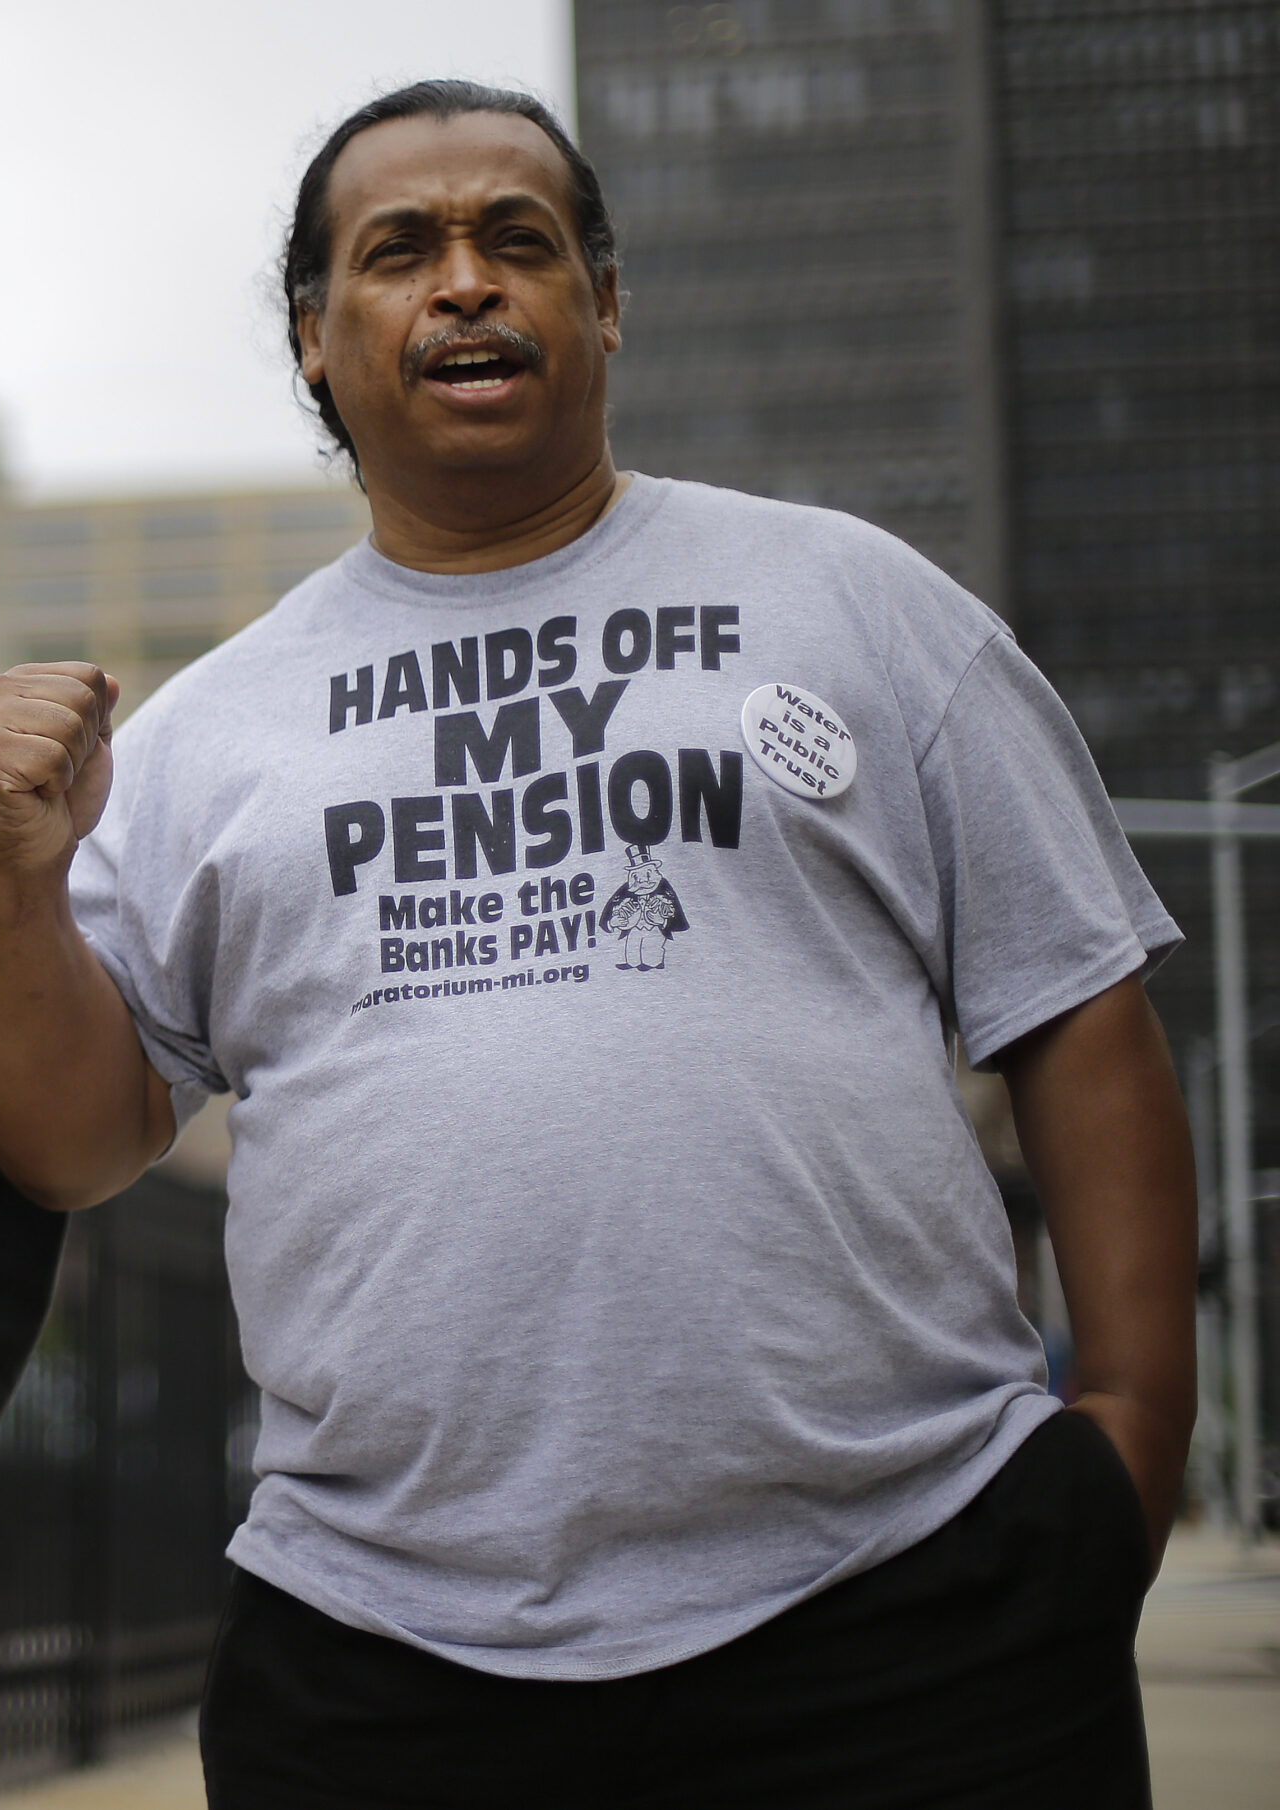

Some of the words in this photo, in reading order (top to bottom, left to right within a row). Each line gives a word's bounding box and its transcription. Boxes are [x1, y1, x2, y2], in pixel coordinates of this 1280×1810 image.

[329, 616, 577, 734] HANDS
[602, 606, 740, 674] OFF
[434, 679, 630, 787] MY
[776, 684, 851, 741] Water
[782, 710, 806, 734] is
[814, 735, 831, 752] a
[759, 717, 839, 780] Public
[760, 739, 826, 795] Trust
[324, 748, 743, 897] PENSION
[378, 890, 504, 931] Make
[518, 872, 595, 916] the
[380, 931, 498, 973] Banks
[510, 910, 597, 960] PAY!
[350, 964, 590, 1017] moratorium-mi.org
